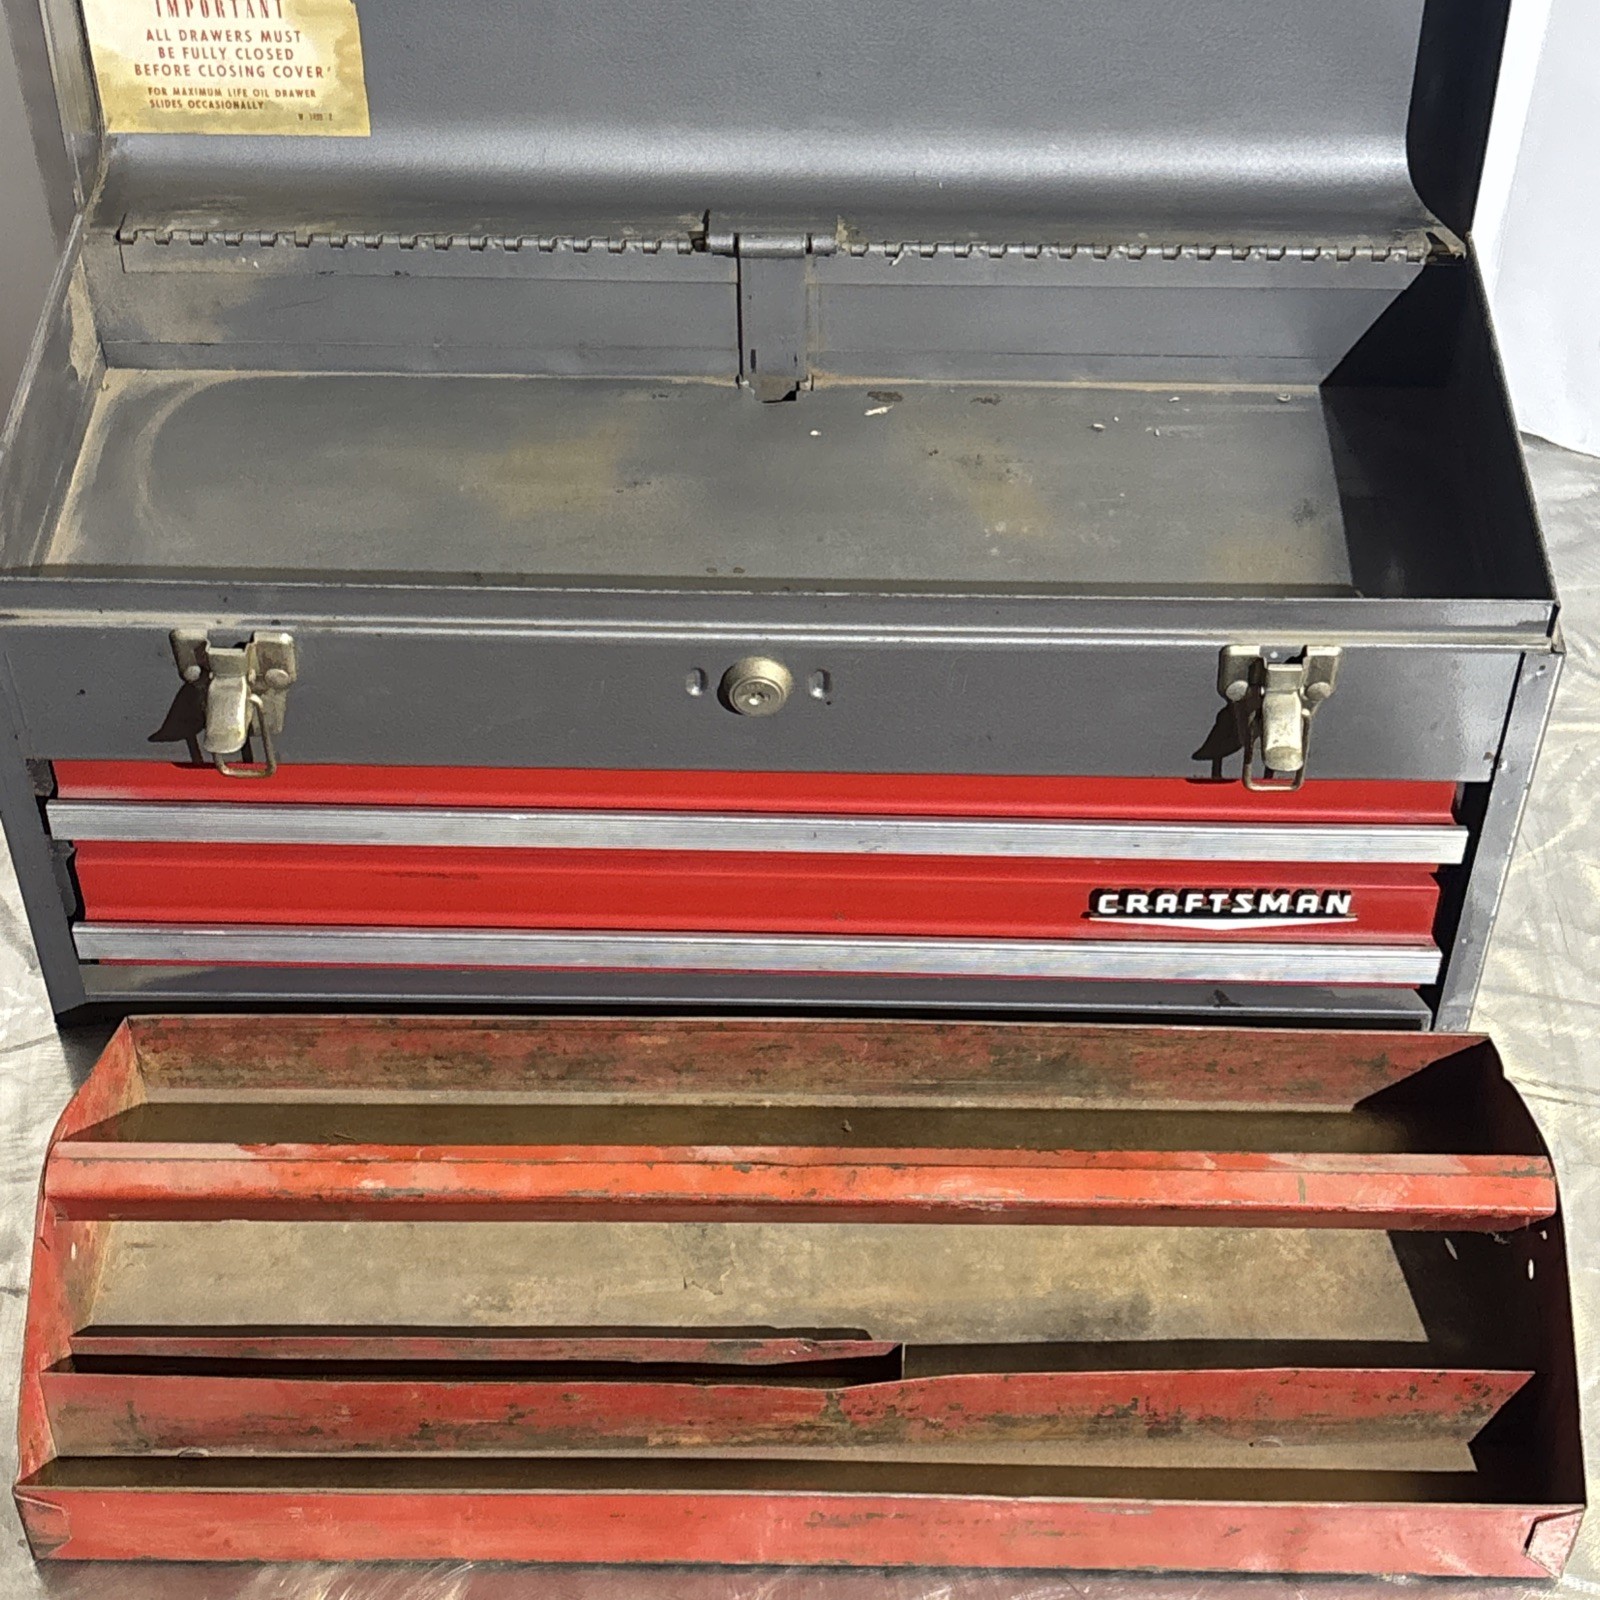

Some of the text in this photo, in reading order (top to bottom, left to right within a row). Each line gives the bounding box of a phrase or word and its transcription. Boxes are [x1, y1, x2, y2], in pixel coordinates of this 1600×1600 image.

[155, 0, 283, 18] IMPORTANT
[147, 30, 301, 43] ALL DRAWERS MUST
[158, 47, 294, 60] BE FULLY CLOSED
[134, 64, 191, 76] BEFORE
[198, 65, 265, 77] CLOSING
[148, 88, 316, 98] FOR MAXIMUM LIFE OIL DRAWER
[150, 100, 264, 110] SLIDES OCCASIONALLY
[1097, 893, 1352, 914] CRAFTSMAN
